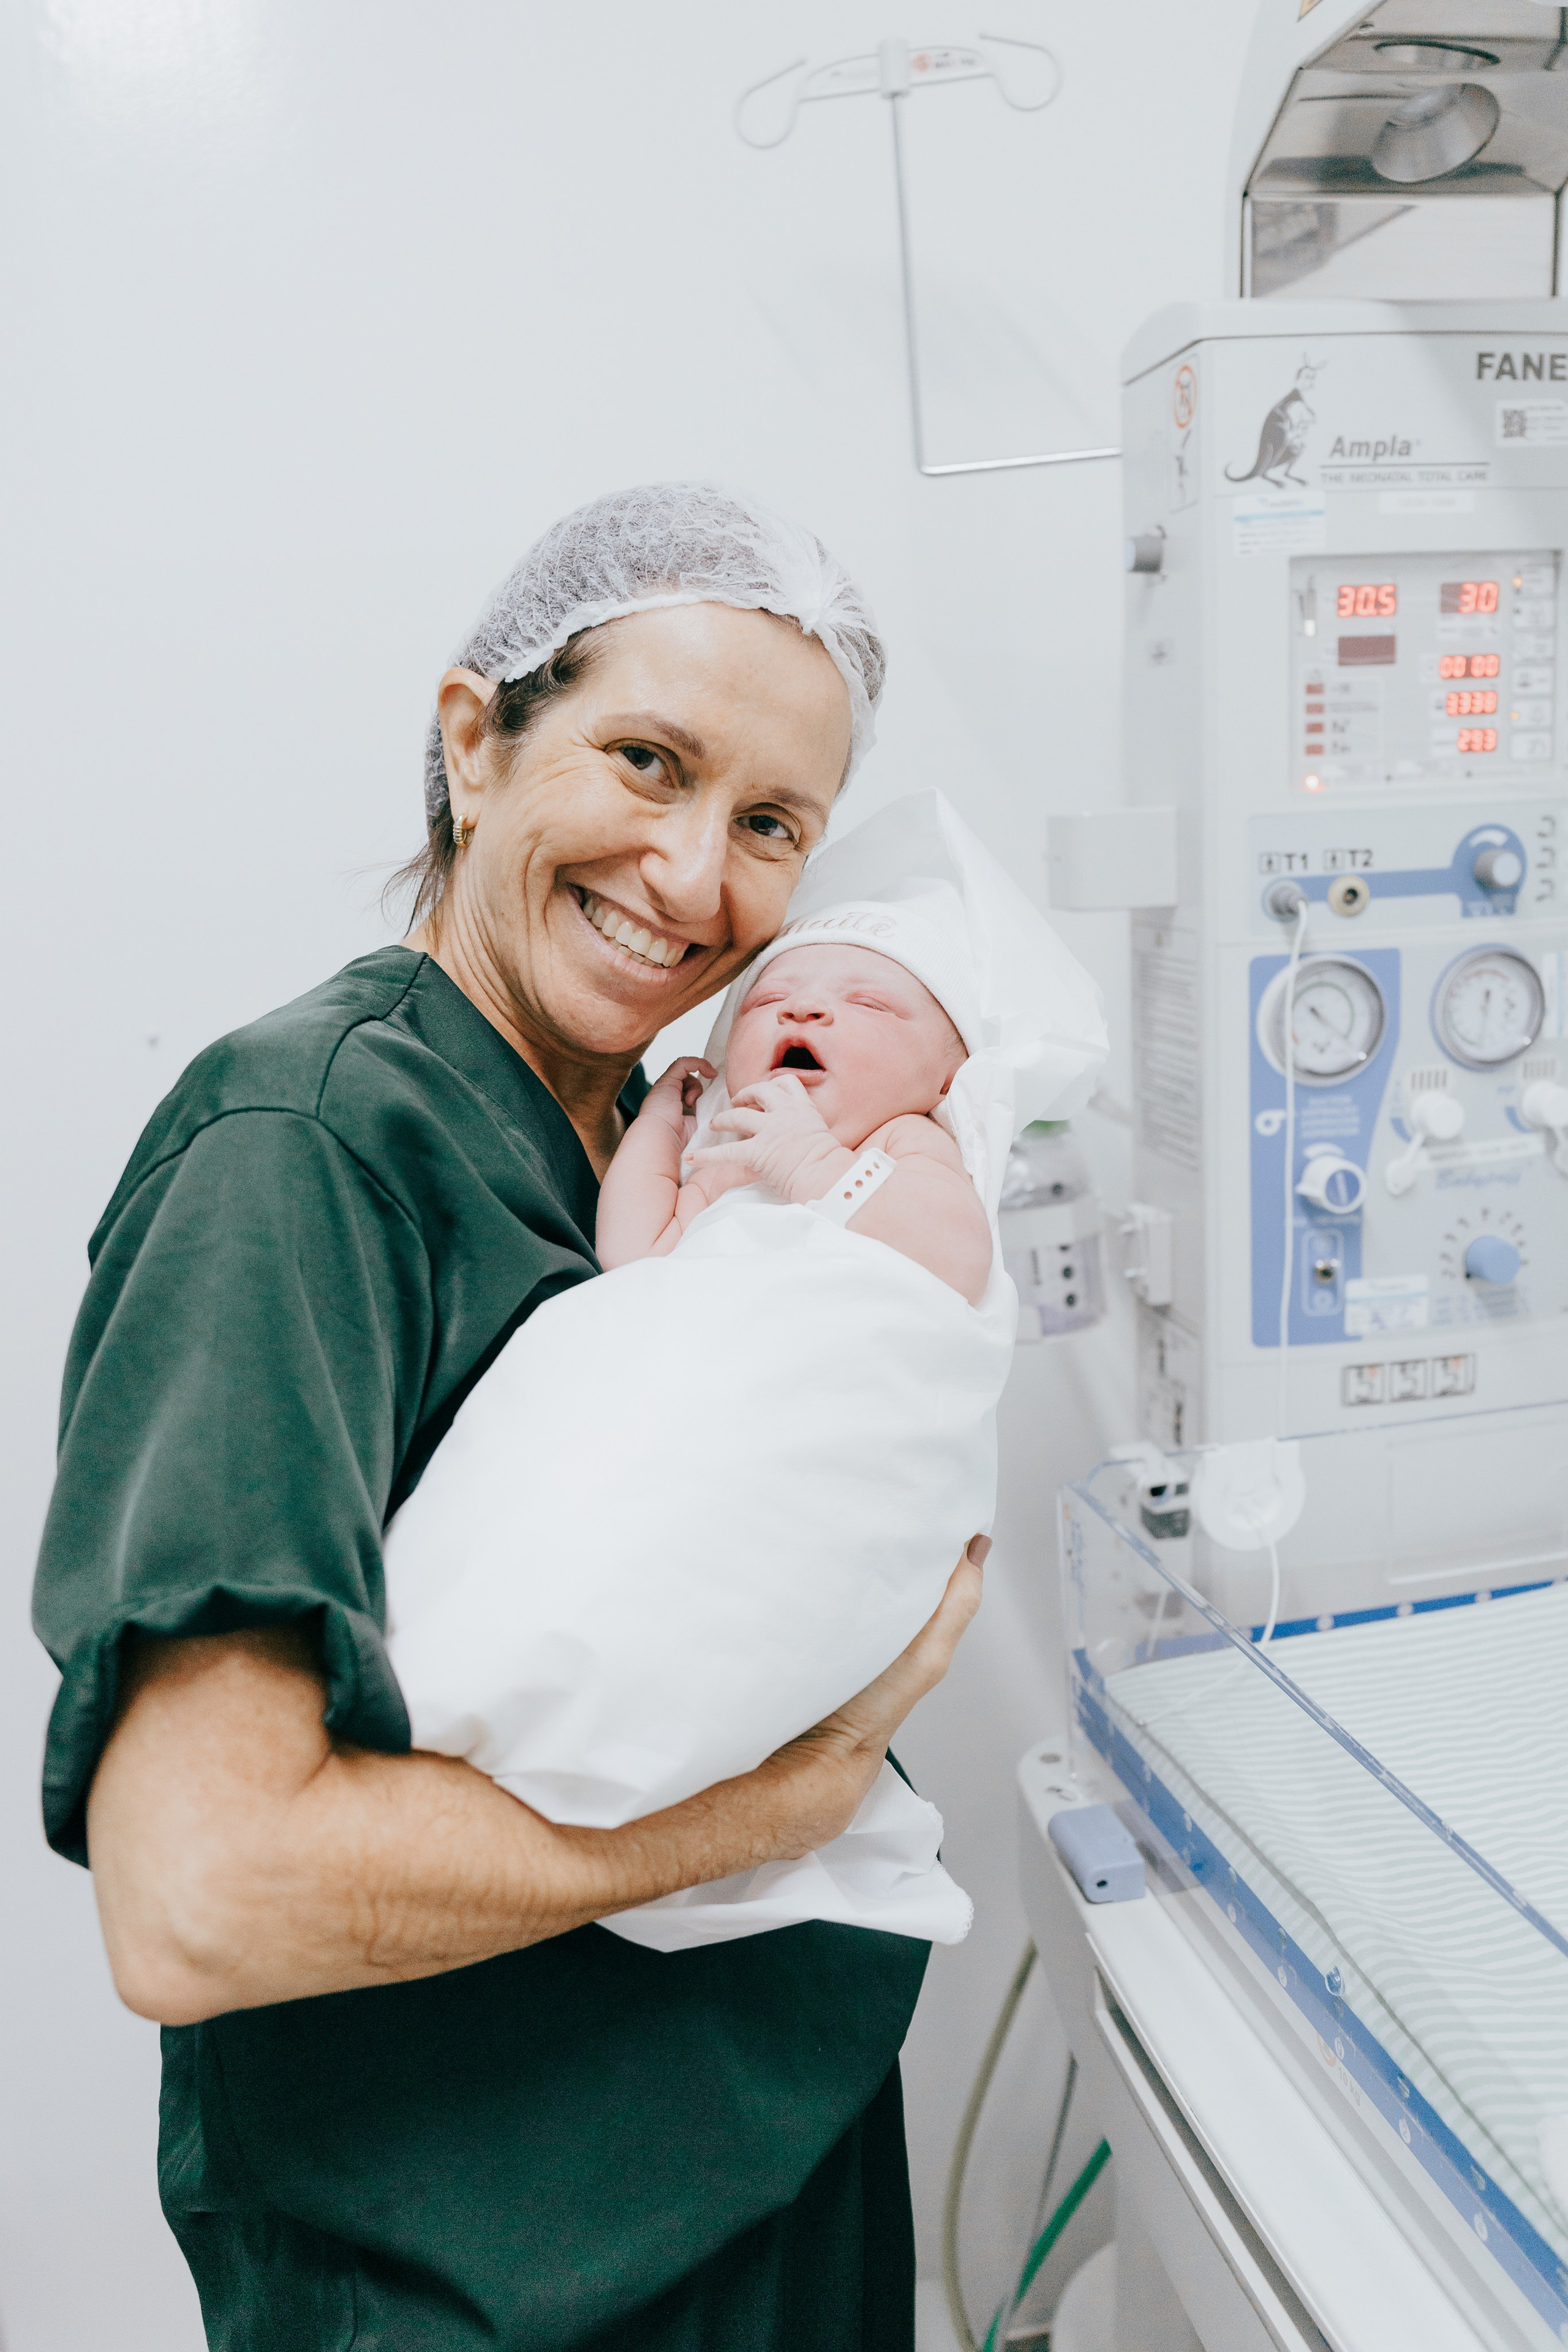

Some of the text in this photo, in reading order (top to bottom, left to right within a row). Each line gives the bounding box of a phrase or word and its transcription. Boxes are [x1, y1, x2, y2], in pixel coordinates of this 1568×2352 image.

[1476, 352, 1568, 381] FANE
[1329, 434, 1413, 463] Ampla
[1321, 472, 1344, 483] THE
[1457, 469, 1488, 481] CARE
[1460, 582, 1498, 614] 30
[1284, 852, 1308, 871] T1
[1349, 848, 1374, 868] T2
